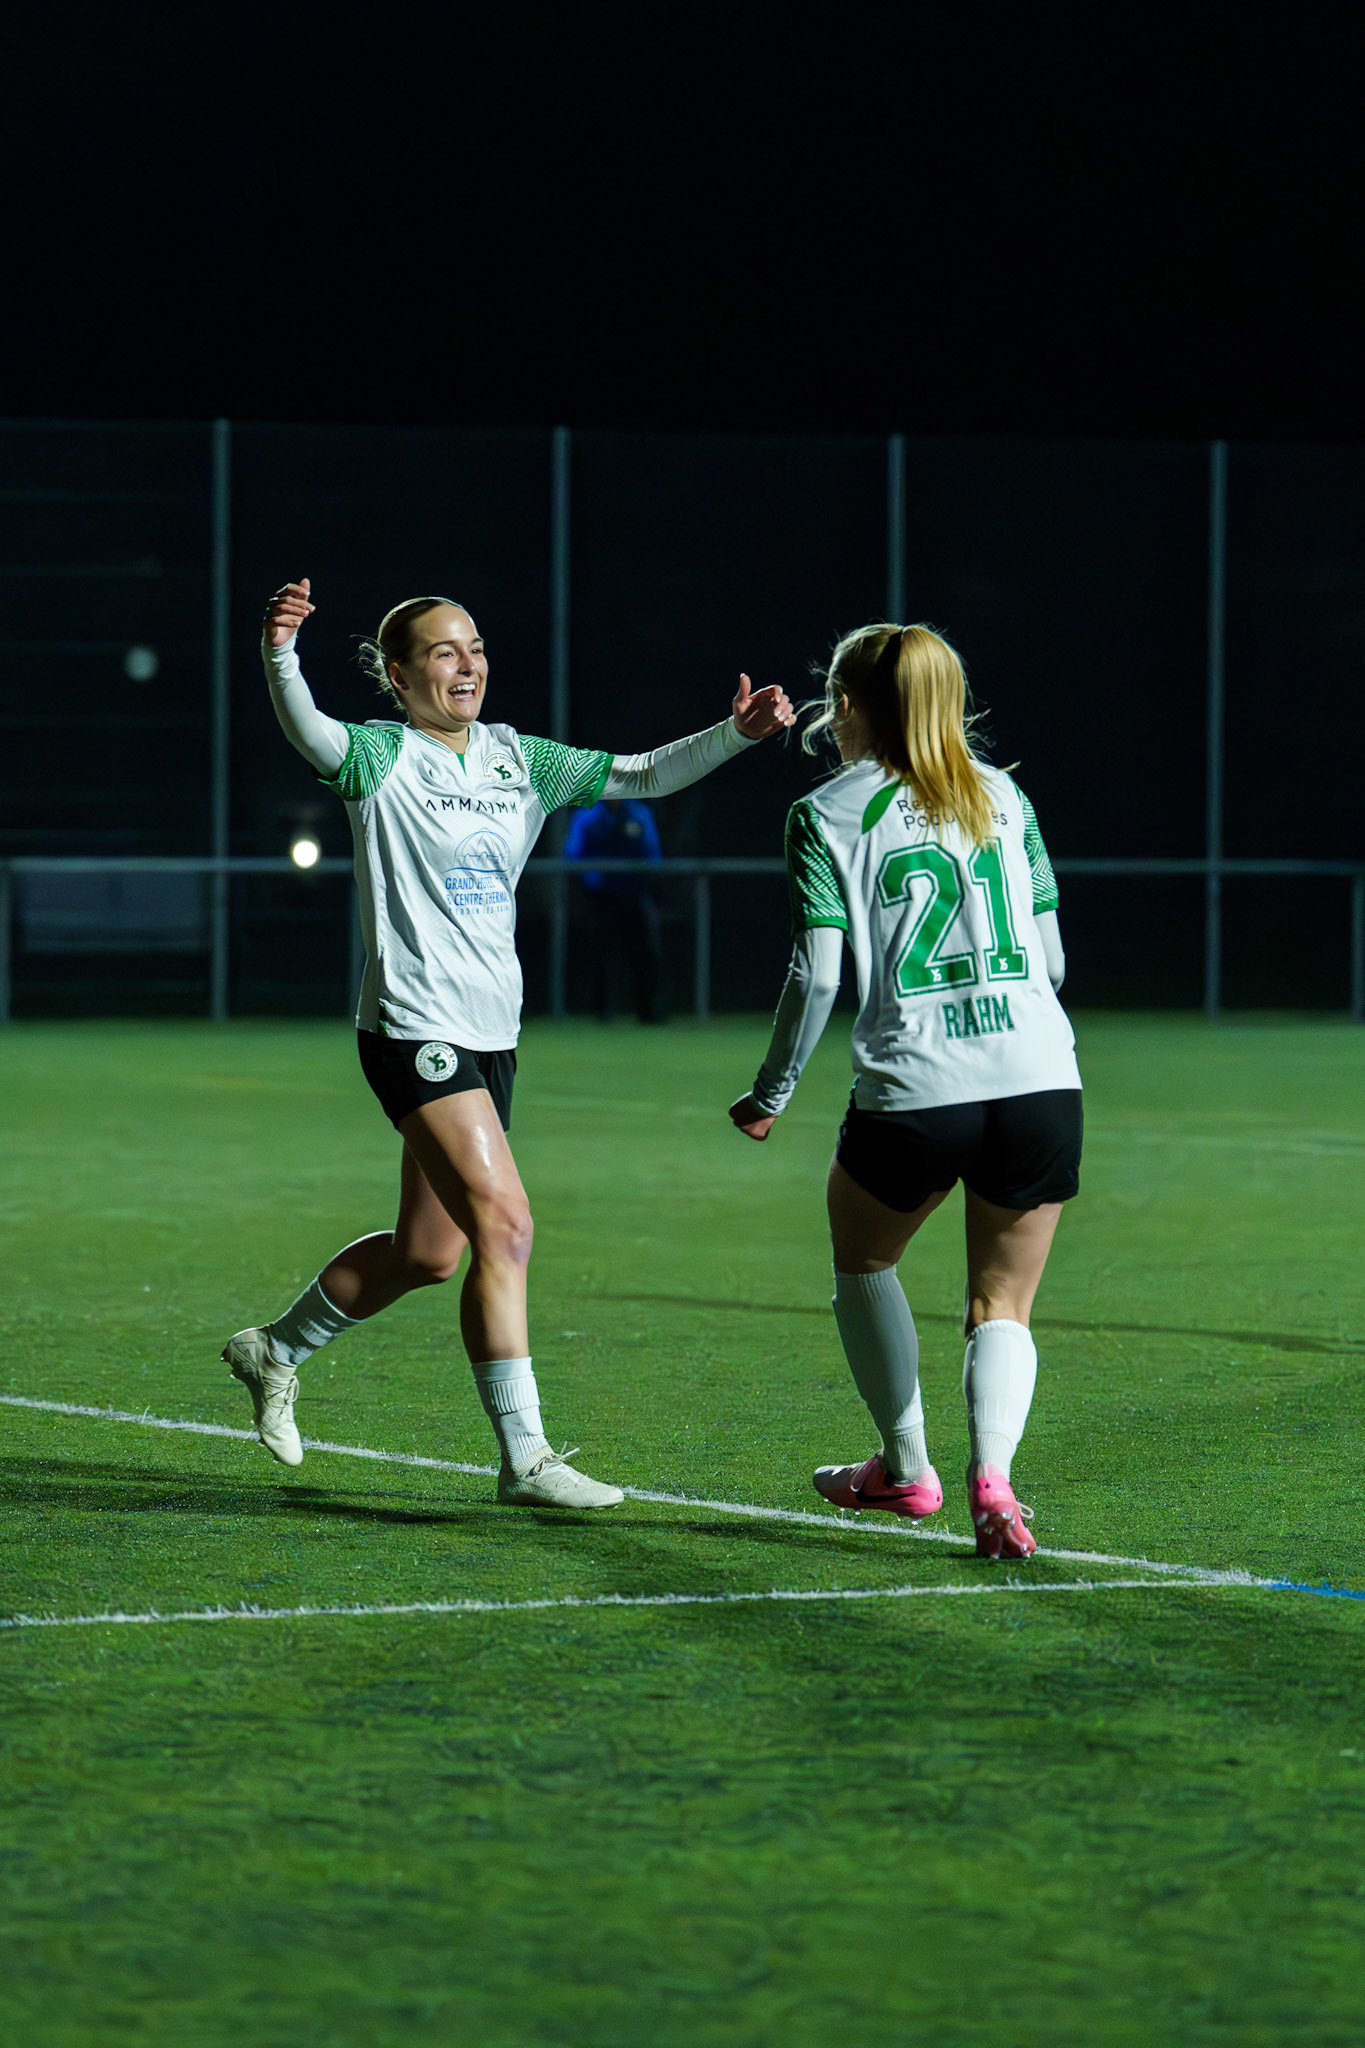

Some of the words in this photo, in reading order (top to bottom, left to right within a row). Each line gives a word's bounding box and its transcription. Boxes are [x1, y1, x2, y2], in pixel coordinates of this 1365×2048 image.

[445, 876, 475, 891] GRAND
[454, 892, 484, 906] CENTRE
[876, 836, 1029, 998] 21
[942, 992, 1015, 1040] RAHM
